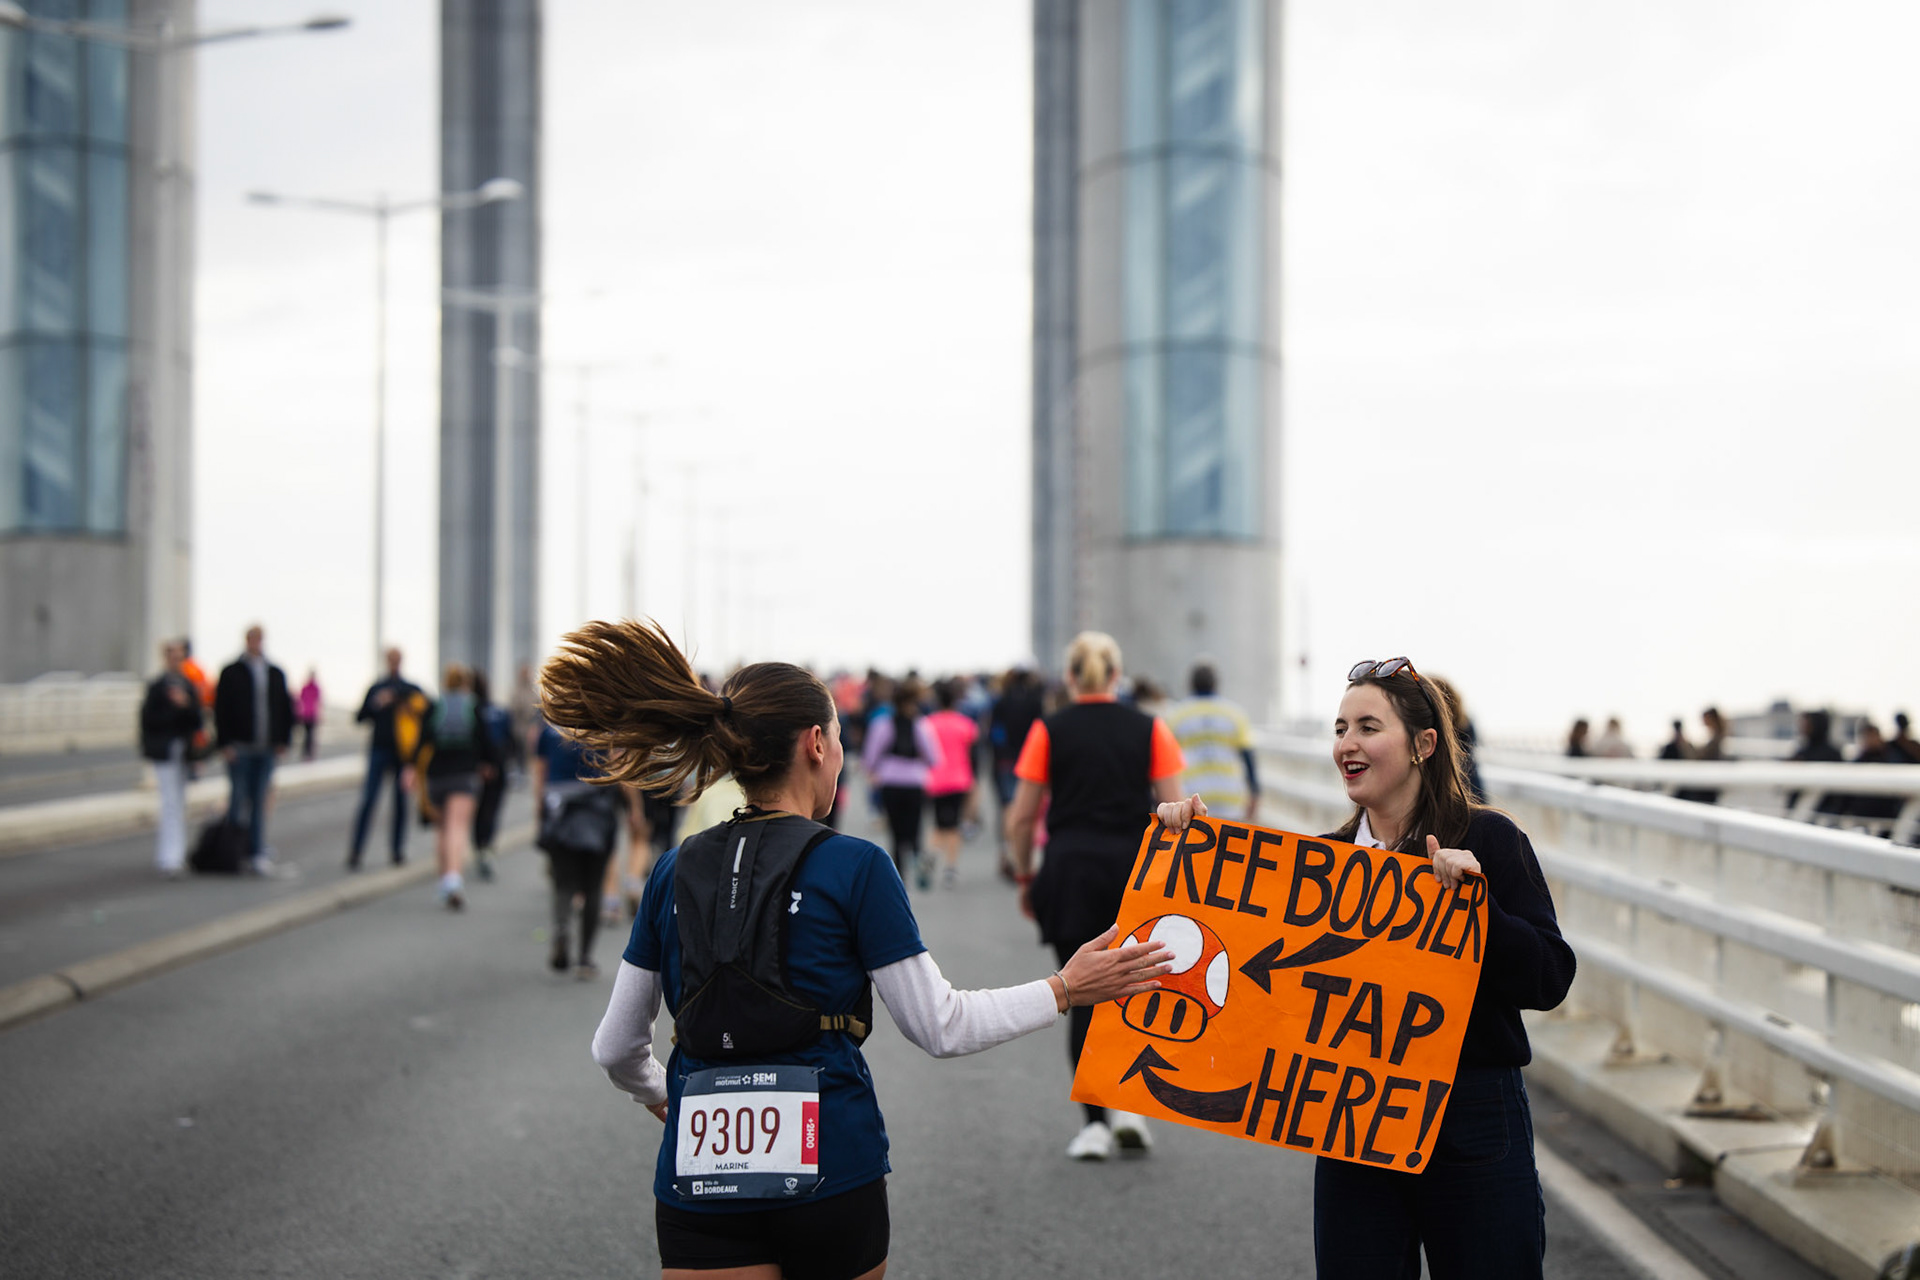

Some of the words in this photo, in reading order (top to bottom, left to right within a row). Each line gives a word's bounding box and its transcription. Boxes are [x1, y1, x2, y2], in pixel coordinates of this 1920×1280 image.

[1133, 819, 1283, 918] FREE
[730, 877, 739, 909] EVADICT
[1301, 971, 1445, 1066] TAP
[753, 1073, 777, 1082] SEMI
[1246, 1047, 1451, 1168] HERE!
[690, 1106, 781, 1157] 9309
[806, 1118, 815, 1149] +2H00
[715, 1162, 749, 1171] MARINE
[704, 1185, 738, 1194] BORDEAUX
